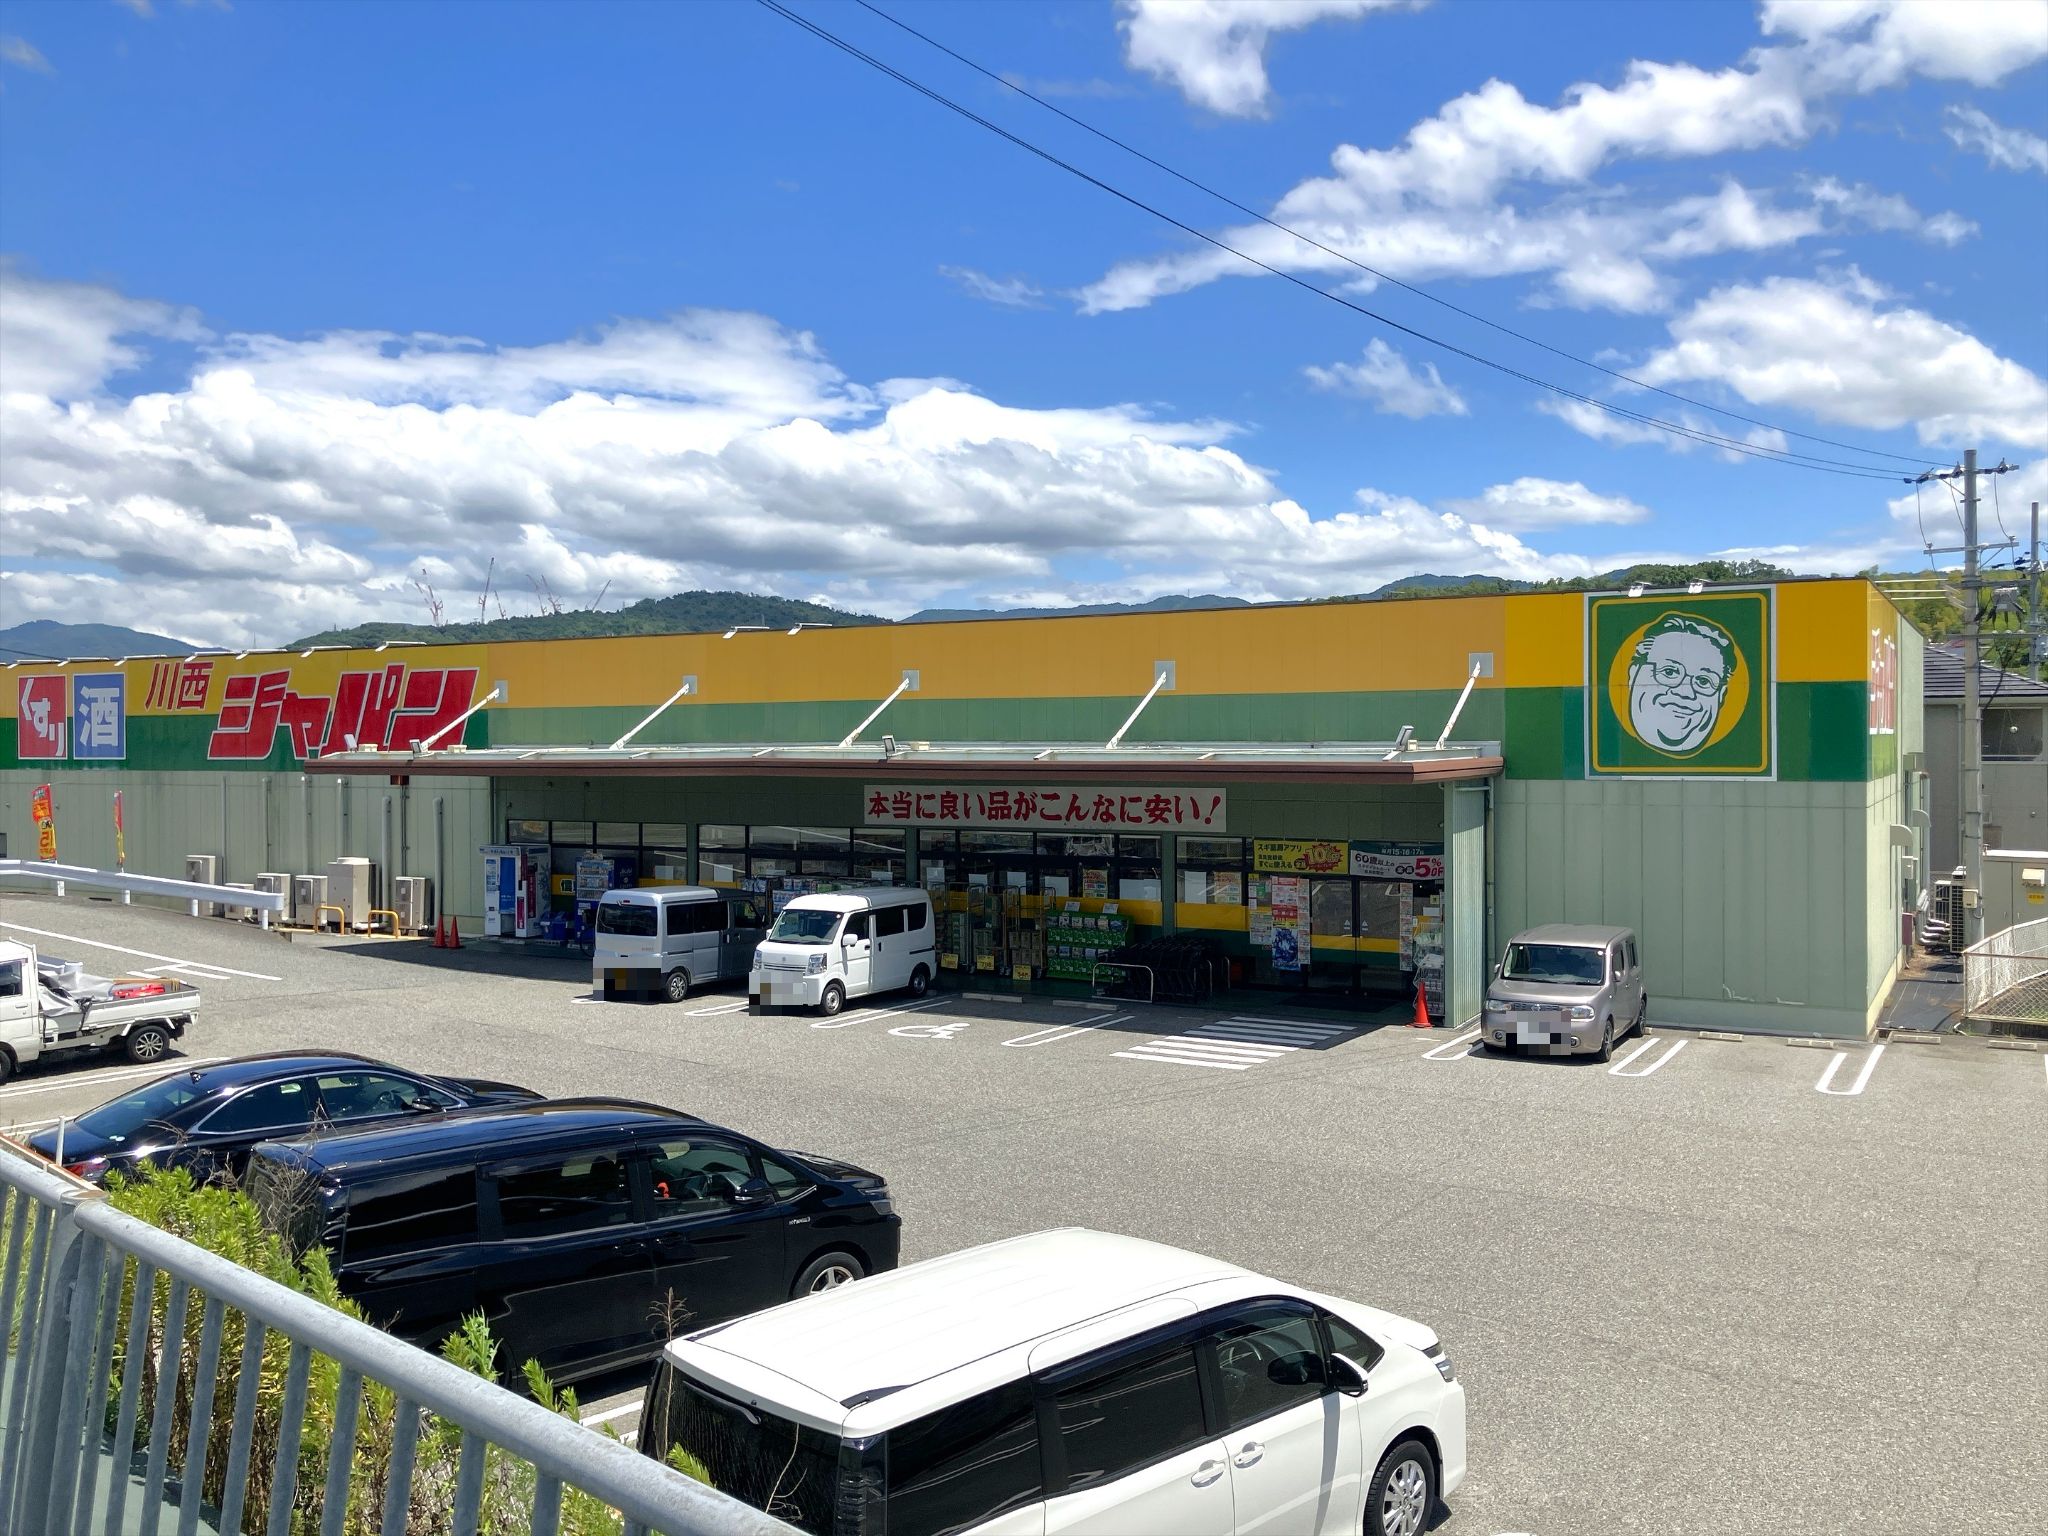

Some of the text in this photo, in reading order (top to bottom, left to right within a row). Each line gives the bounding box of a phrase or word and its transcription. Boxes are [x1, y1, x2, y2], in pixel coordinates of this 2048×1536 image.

[20, 678, 65, 758] くすり
[78, 685, 120, 748] 酒
[144, 661, 480, 760] 川西 ジャパン
